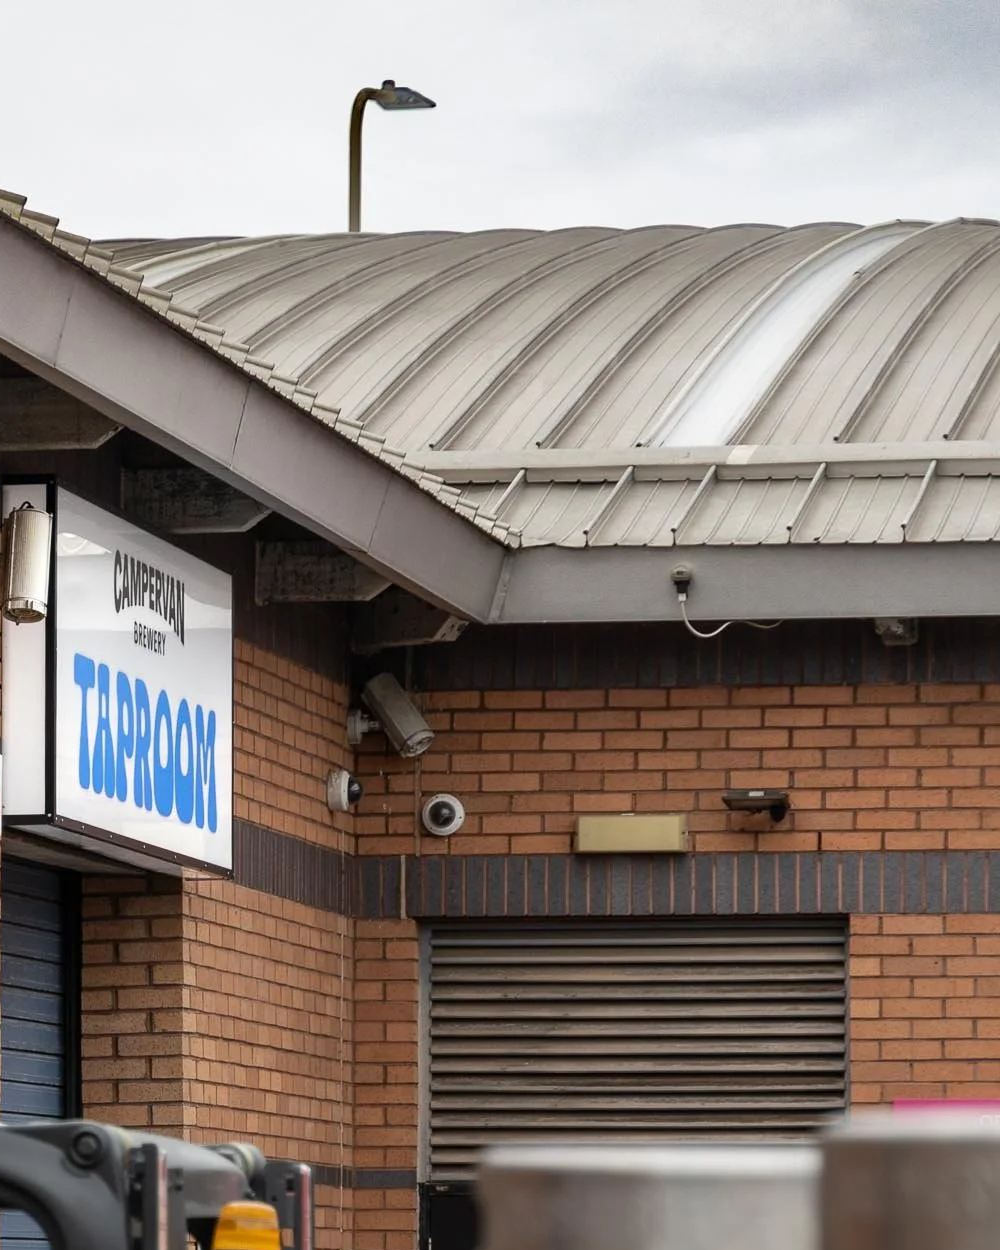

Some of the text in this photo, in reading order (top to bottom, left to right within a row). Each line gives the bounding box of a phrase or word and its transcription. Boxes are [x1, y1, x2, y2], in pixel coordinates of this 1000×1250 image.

[113, 549, 185, 646] CAMPERVAN
[133, 620, 166, 657] BREWERY
[73, 652, 218, 833] TAPROOM
